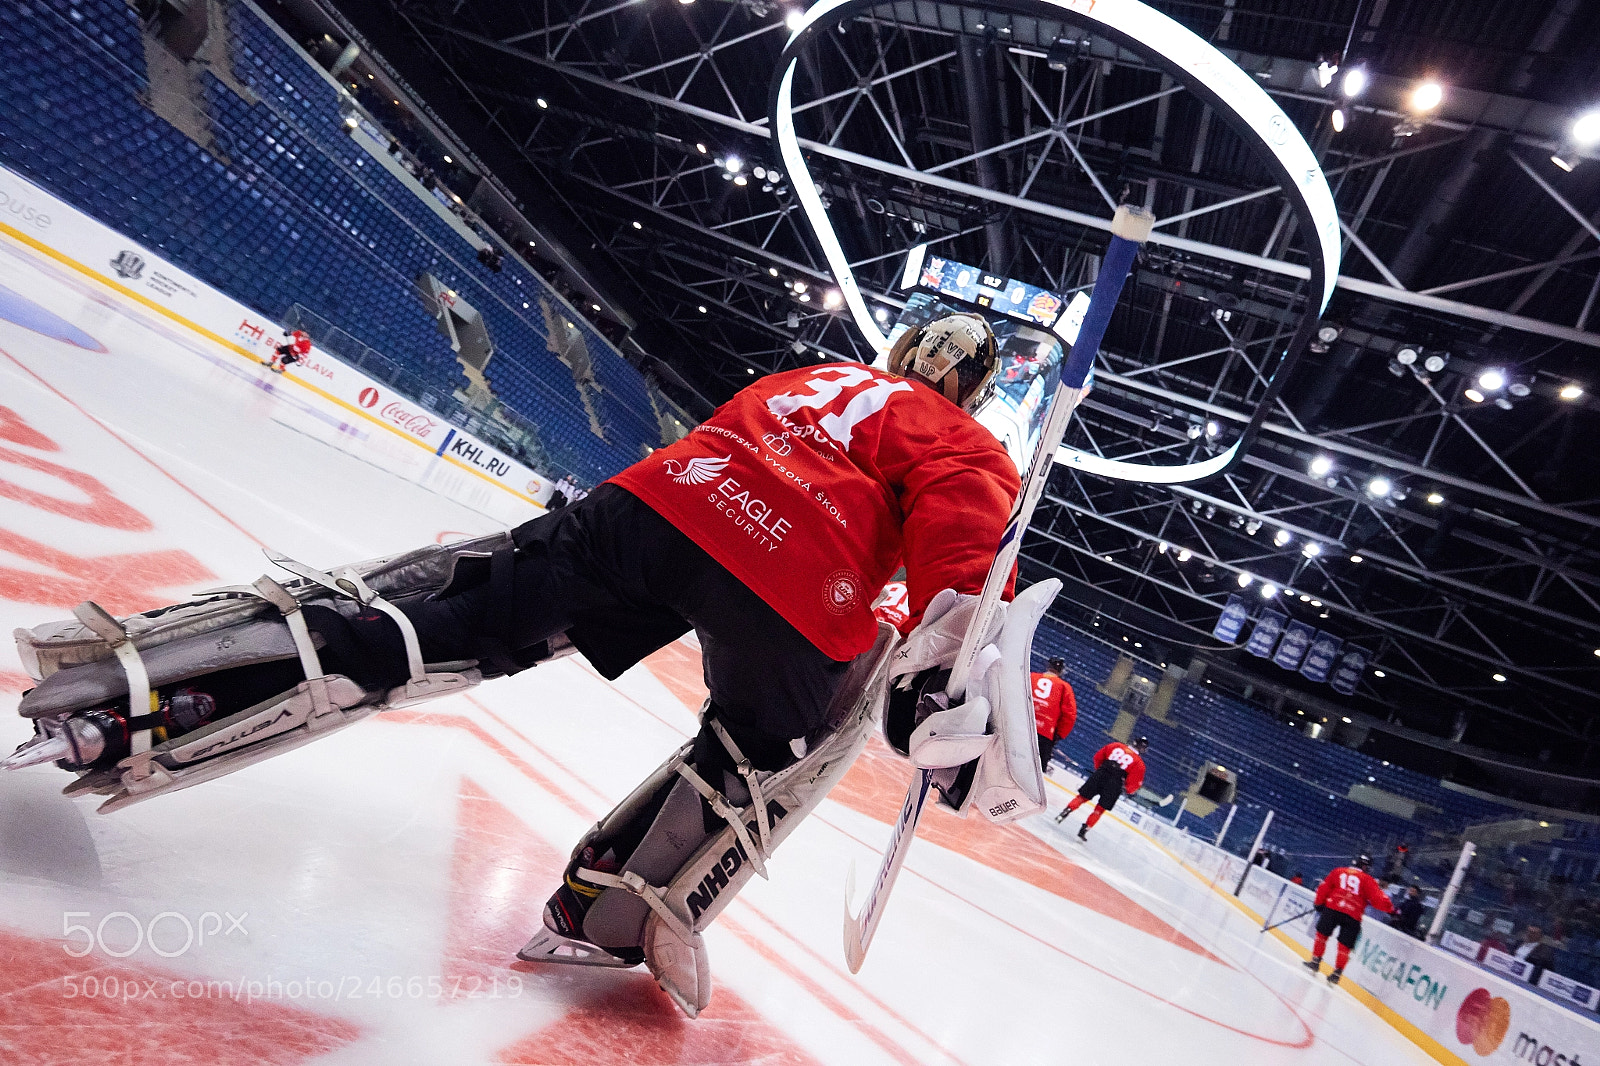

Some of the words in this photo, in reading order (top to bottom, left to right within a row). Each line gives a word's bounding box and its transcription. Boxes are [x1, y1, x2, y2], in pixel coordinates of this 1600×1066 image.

[265, 331, 335, 381] BRSLAVA
[766, 366, 914, 453] 31
[450, 437, 510, 477] KHL.RU
[707, 492, 778, 553] SECURITY
[717, 476, 793, 542] EAGLE
[1034, 677, 1053, 700] 9
[989, 799, 1020, 817] BAUER
[1338, 872, 1361, 895] 19
